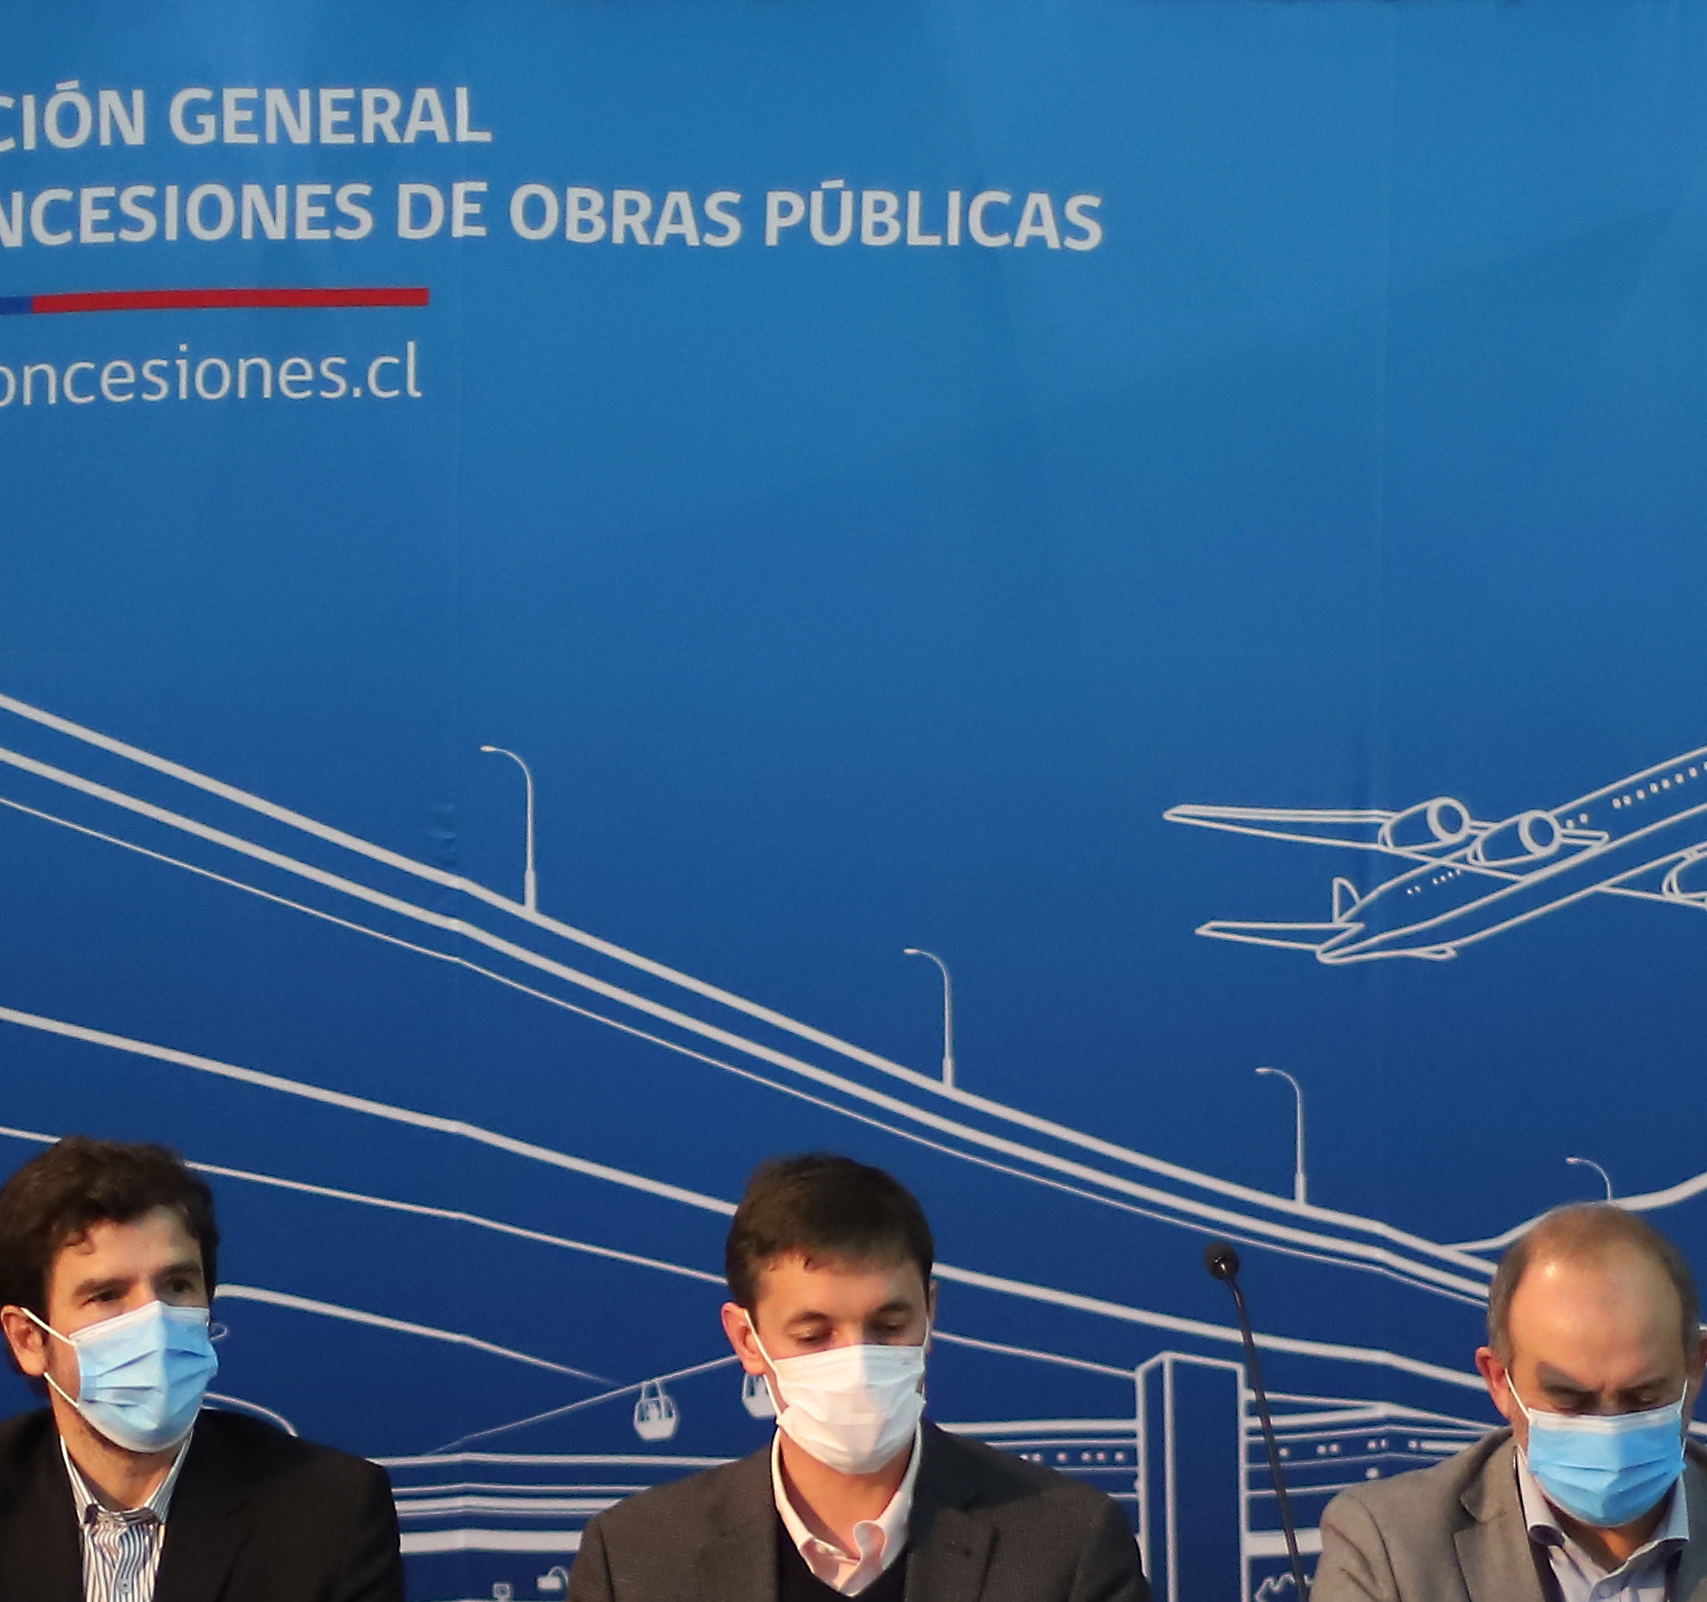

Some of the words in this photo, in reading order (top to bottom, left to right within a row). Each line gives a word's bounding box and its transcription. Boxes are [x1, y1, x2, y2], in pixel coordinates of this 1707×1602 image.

[168, 85, 493, 146] GENERAL
[396, 180, 489, 241] DE
[508, 182, 743, 248] OBRAS
[764, 177, 1104, 252] PÚBLICAS
